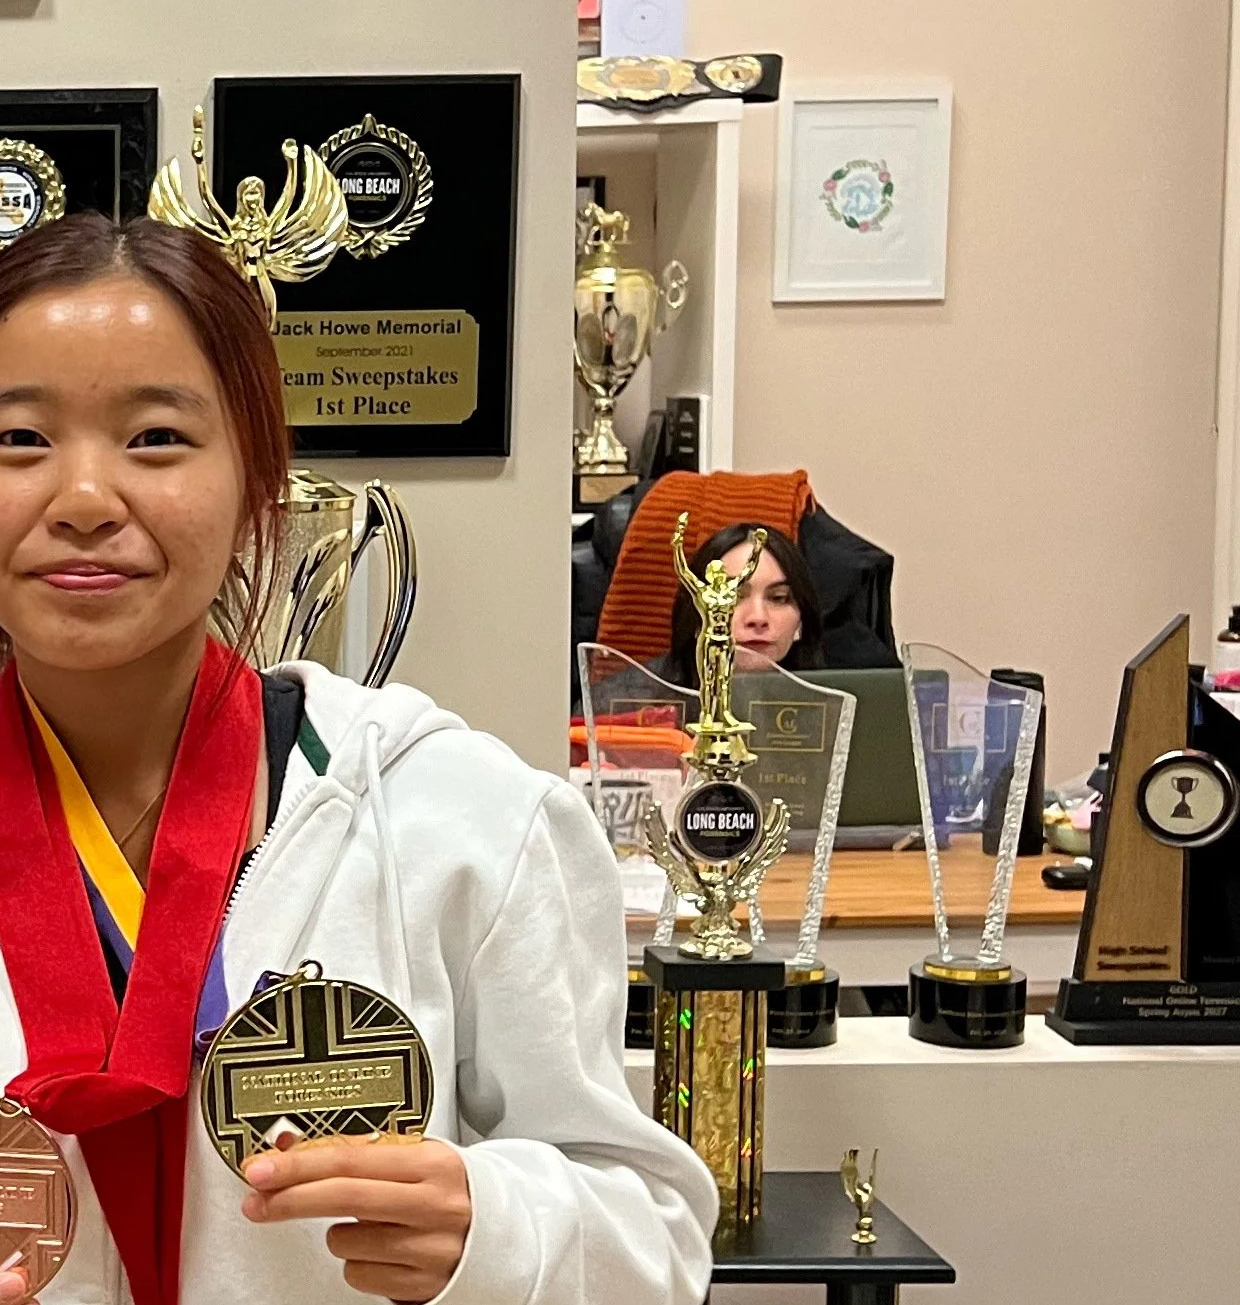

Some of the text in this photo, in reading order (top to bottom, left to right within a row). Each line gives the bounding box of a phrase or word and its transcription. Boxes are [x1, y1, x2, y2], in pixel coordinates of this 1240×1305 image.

[337, 178, 401, 195] ONG BEACH
[272, 319, 462, 336] Jack Howe Memorial
[316, 345, 414, 359] September 2021
[331, 366, 459, 391] Sweepstakes
[316, 396, 412, 415] 1st Place
[686, 812, 755, 830] LONG BEACH
